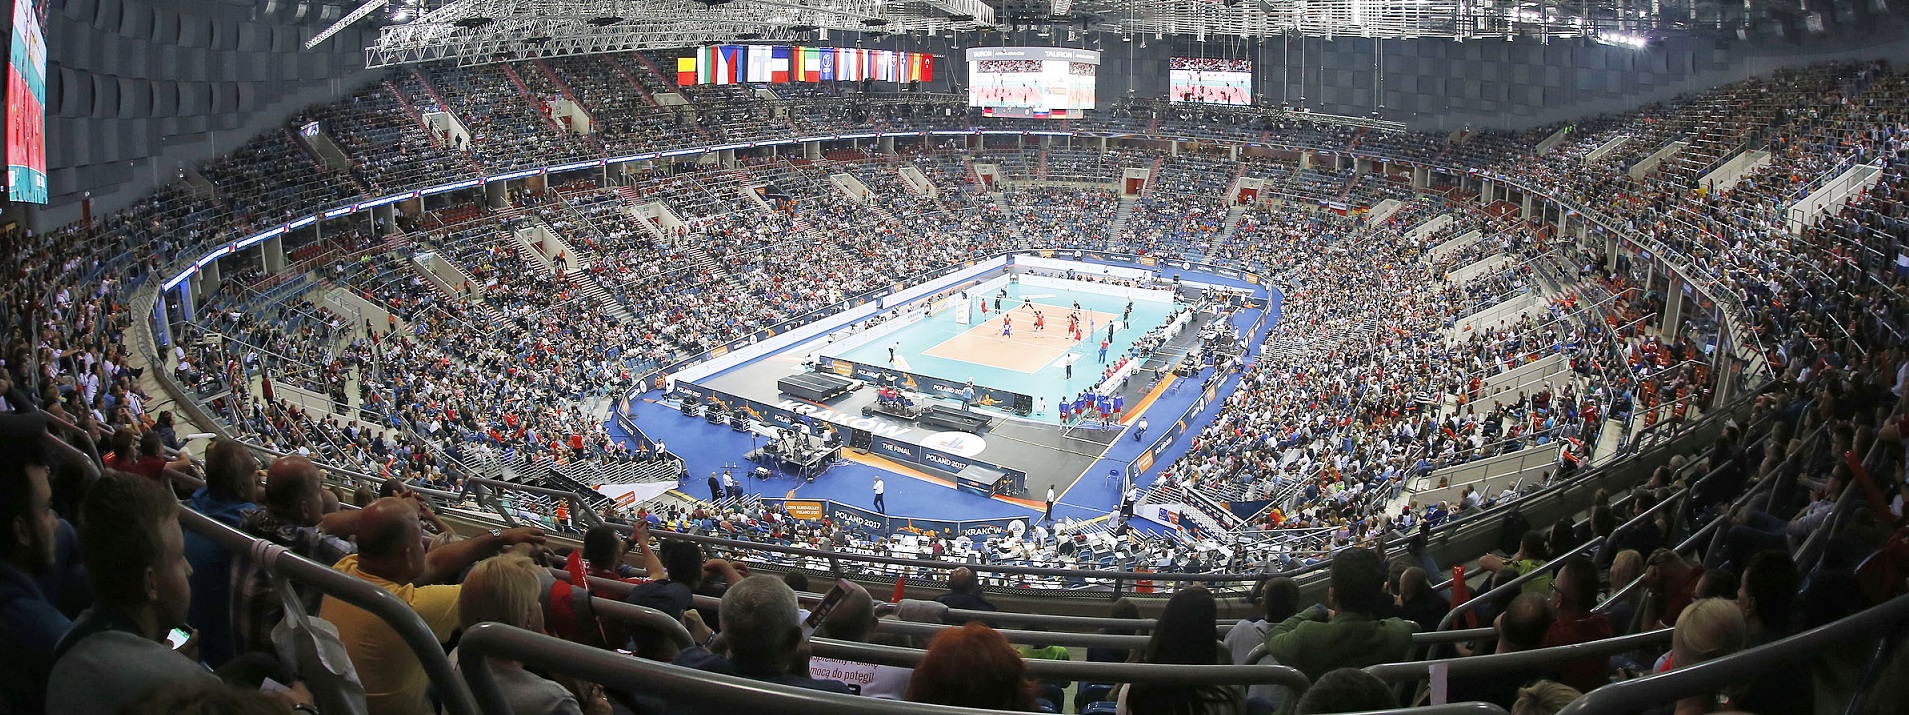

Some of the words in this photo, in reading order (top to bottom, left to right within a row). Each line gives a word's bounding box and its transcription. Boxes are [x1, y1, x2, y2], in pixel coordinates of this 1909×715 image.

[1045, 50, 1072, 58] TAURON
[933, 384, 954, 393] POLAND
[882, 442, 893, 451] THE
[893, 445, 911, 456] FINAL
[926, 453, 950, 466] POLAND
[951, 460, 967, 469] 2017
[834, 510, 863, 525] POLAND
[864, 520, 881, 530] 2017
[832, 667, 842, 679] do
[843, 670, 875, 684] potęgi!
